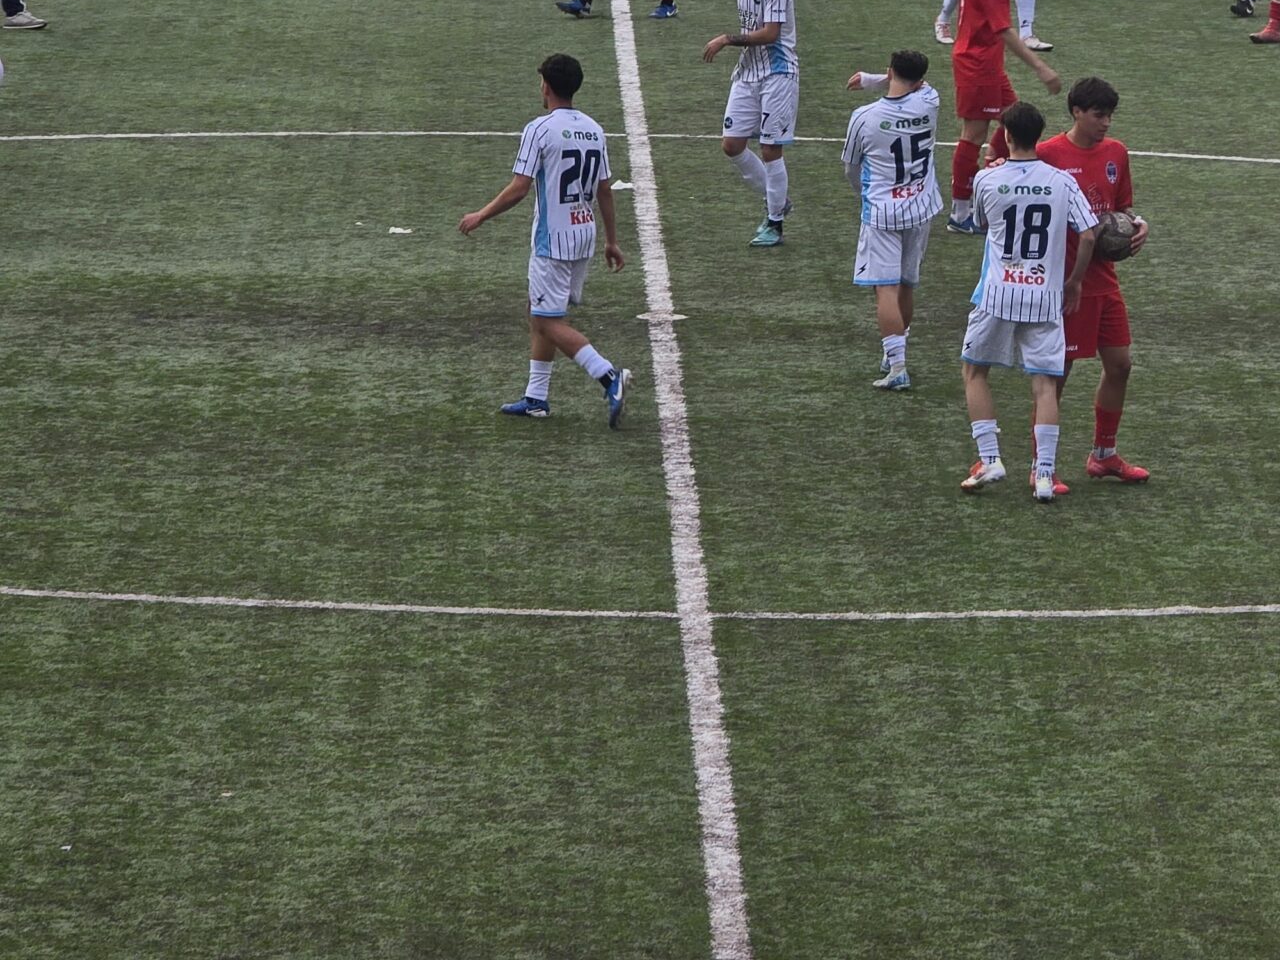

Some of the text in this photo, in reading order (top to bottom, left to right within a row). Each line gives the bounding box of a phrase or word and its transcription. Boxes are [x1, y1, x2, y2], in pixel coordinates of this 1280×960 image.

[895, 114, 930, 129] mes
[573, 130, 599, 141] mes
[889, 130, 932, 185] 15
[559, 148, 601, 205] 20
[1014, 185, 1052, 196] mes
[1001, 203, 1052, 261] 18
[1002, 269, 1045, 286] Kico
